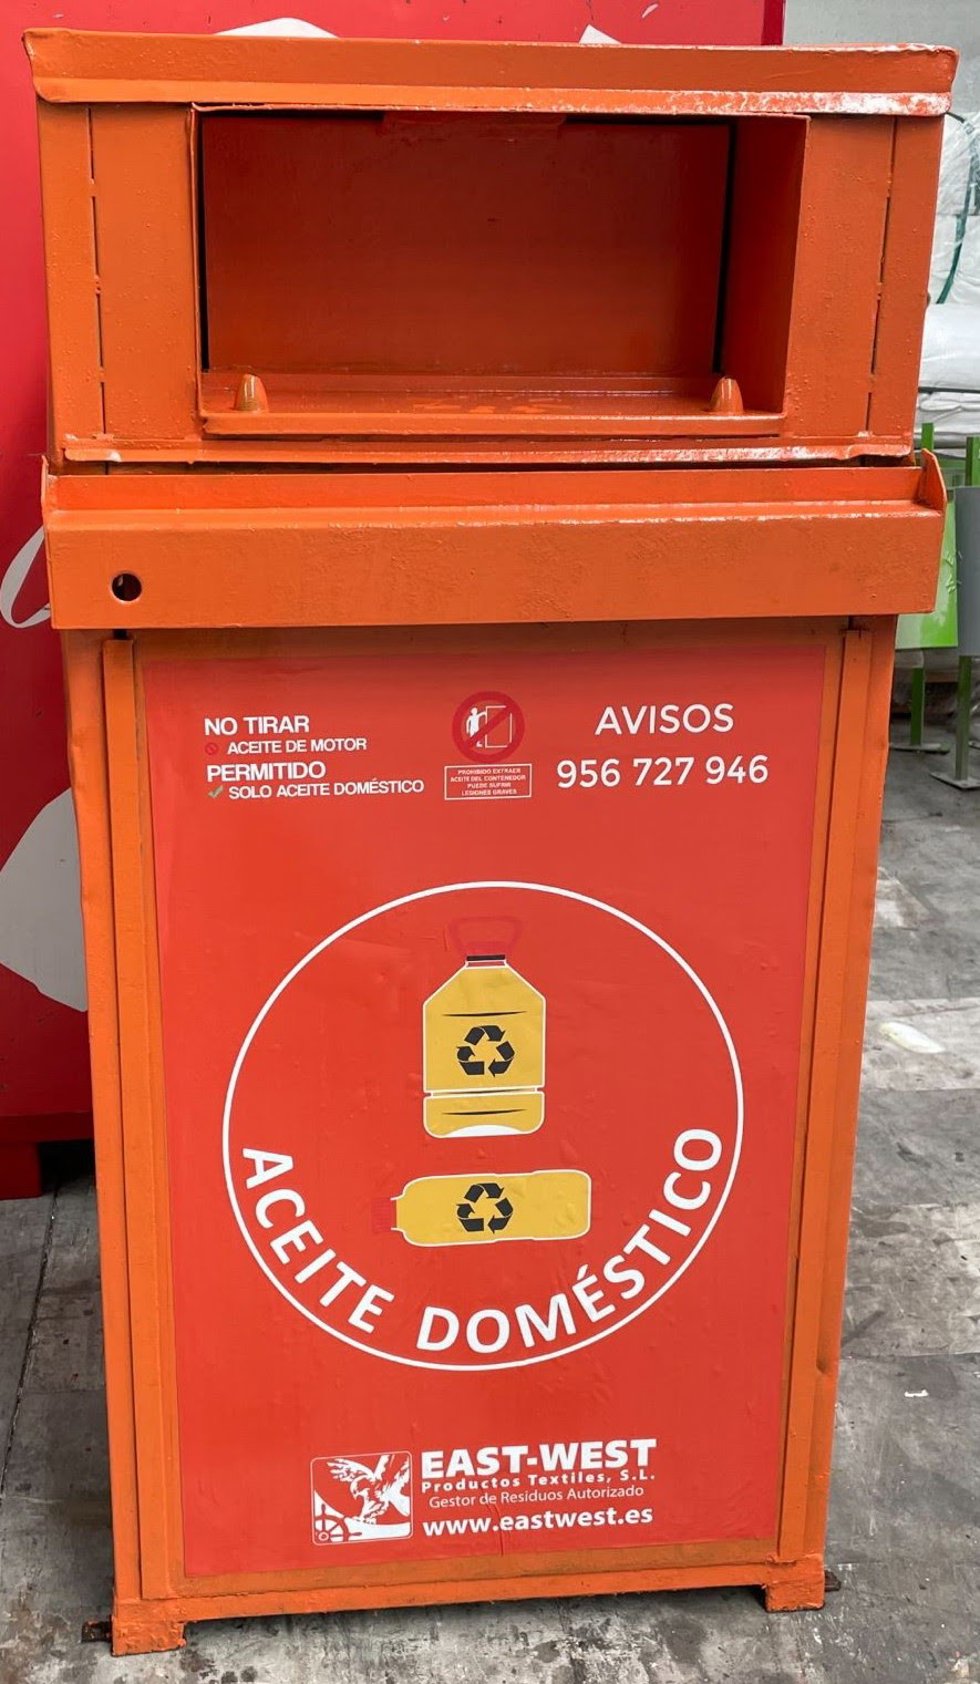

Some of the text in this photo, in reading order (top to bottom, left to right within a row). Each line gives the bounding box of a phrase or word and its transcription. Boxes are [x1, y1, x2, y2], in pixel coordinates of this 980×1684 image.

[204, 715, 310, 736] NO TIRAR
[594, 704, 734, 735] AVISOS
[227, 738, 367, 754] ACEITE DE MOTOR
[207, 762, 326, 782] PERMITIDO
[556, 754, 769, 788] 956 727 946
[228, 778, 424, 800] SOLO ACEITE DOMÉSTICO
[242, 1128, 722, 1354] ACEITE DOMÉSTICO
[421, 1438, 657, 1479] EAST-WEST
[422, 1470, 656, 1493] Productos Textiles, S.L.
[428, 1495, 476, 1509] Gestor
[479, 1492, 497, 1505] de
[567, 1486, 644, 1500] Autorizado
[422, 1506, 654, 1536] www.eastwest.es
